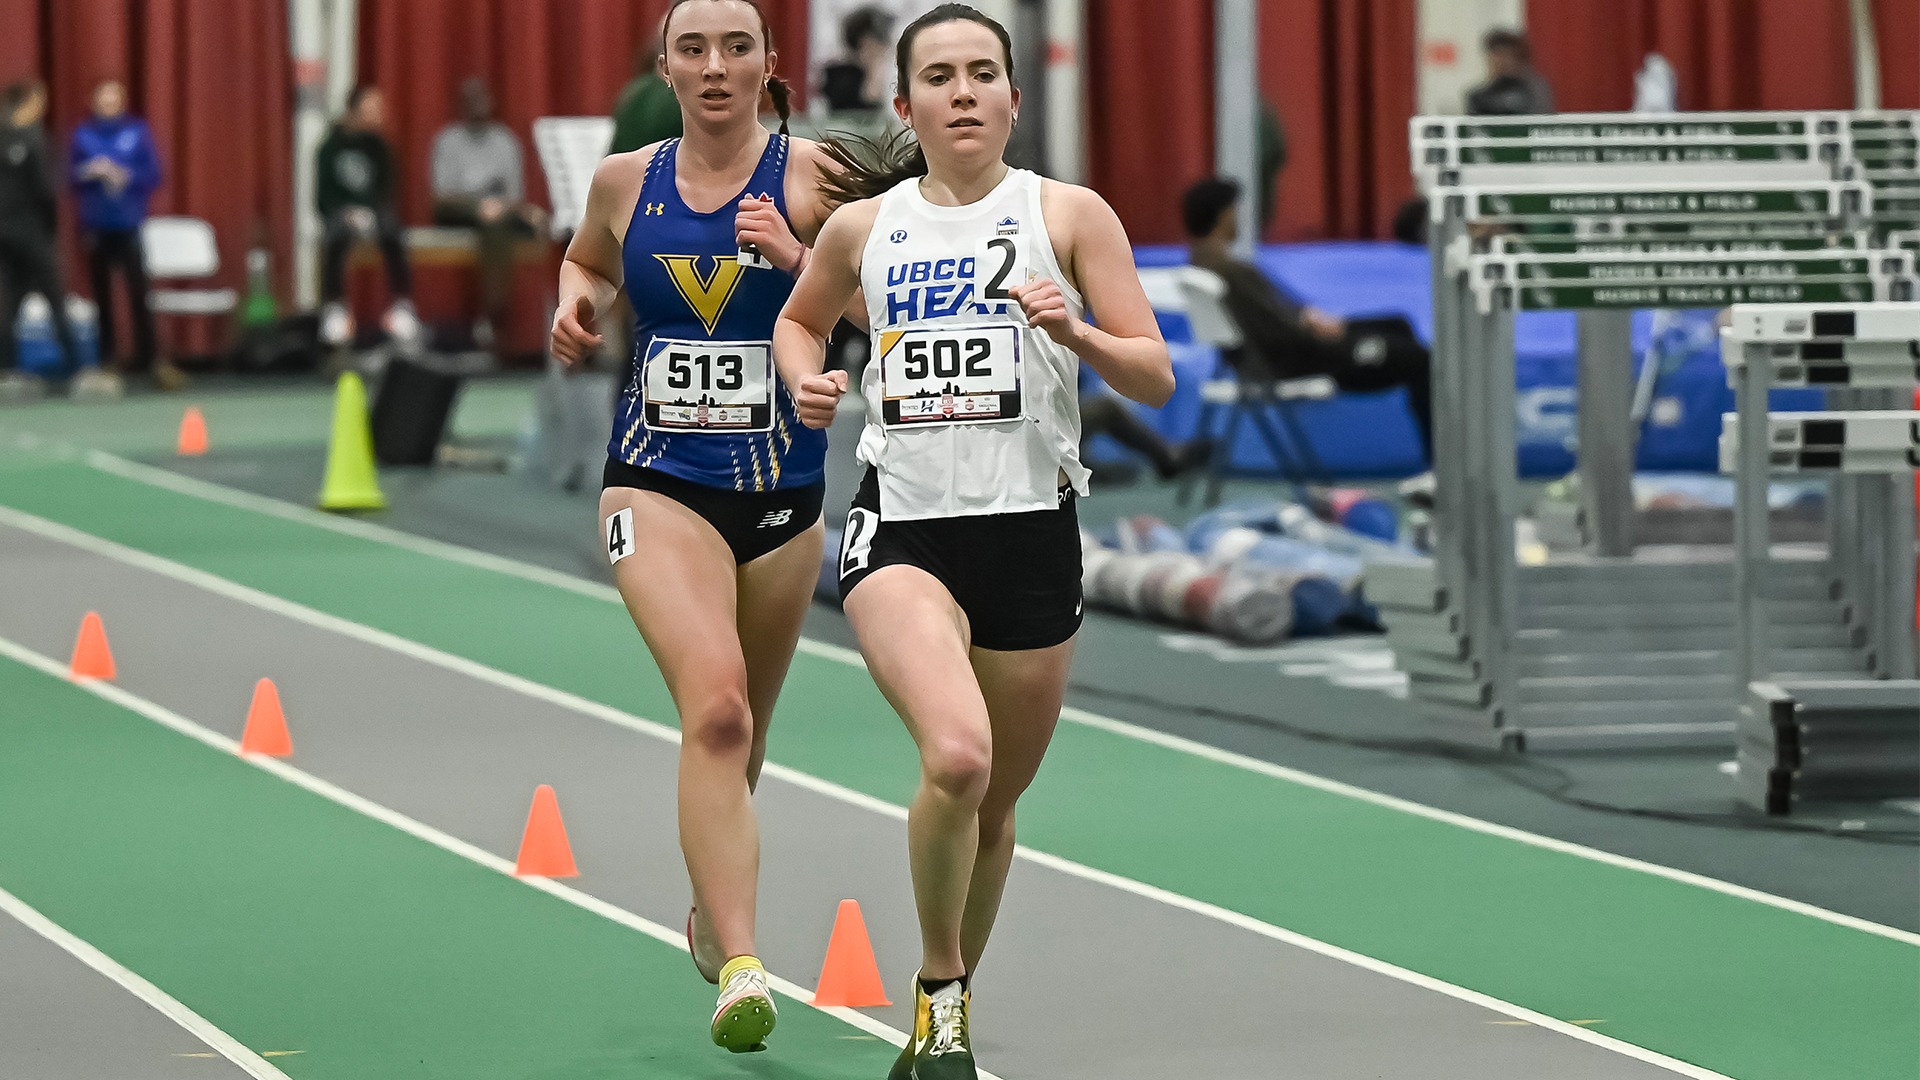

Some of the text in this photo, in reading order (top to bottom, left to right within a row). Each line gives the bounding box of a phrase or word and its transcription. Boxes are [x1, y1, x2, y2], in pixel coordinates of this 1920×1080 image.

[887, 257, 974, 287] UBCO
[985, 238, 1016, 300] 2
[652, 254, 746, 336] V
[668, 352, 743, 390] 513
[905, 338, 992, 380] 502
[608, 514, 626, 557] 4
[843, 510, 865, 575] 2
